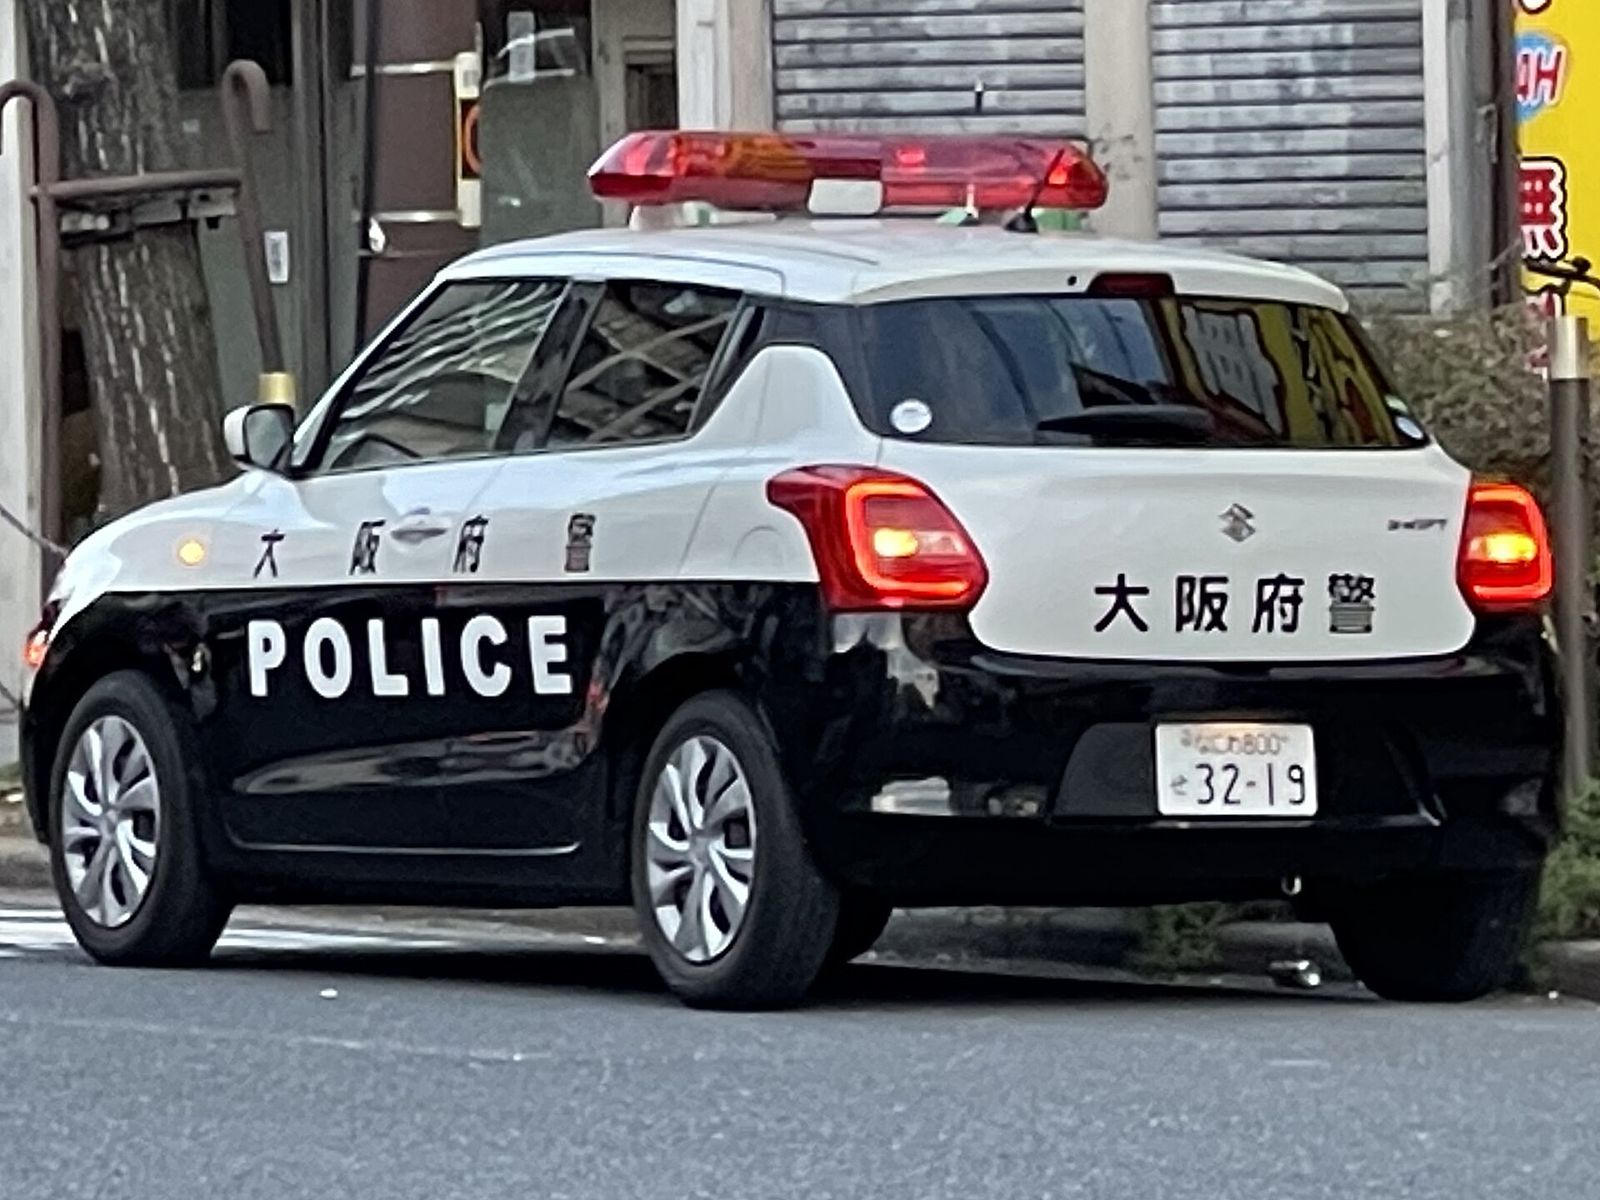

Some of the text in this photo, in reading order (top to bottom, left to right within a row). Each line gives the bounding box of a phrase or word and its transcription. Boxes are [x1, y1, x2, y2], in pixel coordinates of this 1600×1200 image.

[254, 514, 596, 579] 大阪府警
[1094, 573, 1376, 634] 大阪府警
[247, 614, 574, 698] POLICE
[1195, 762, 1306, 806] 32-19
